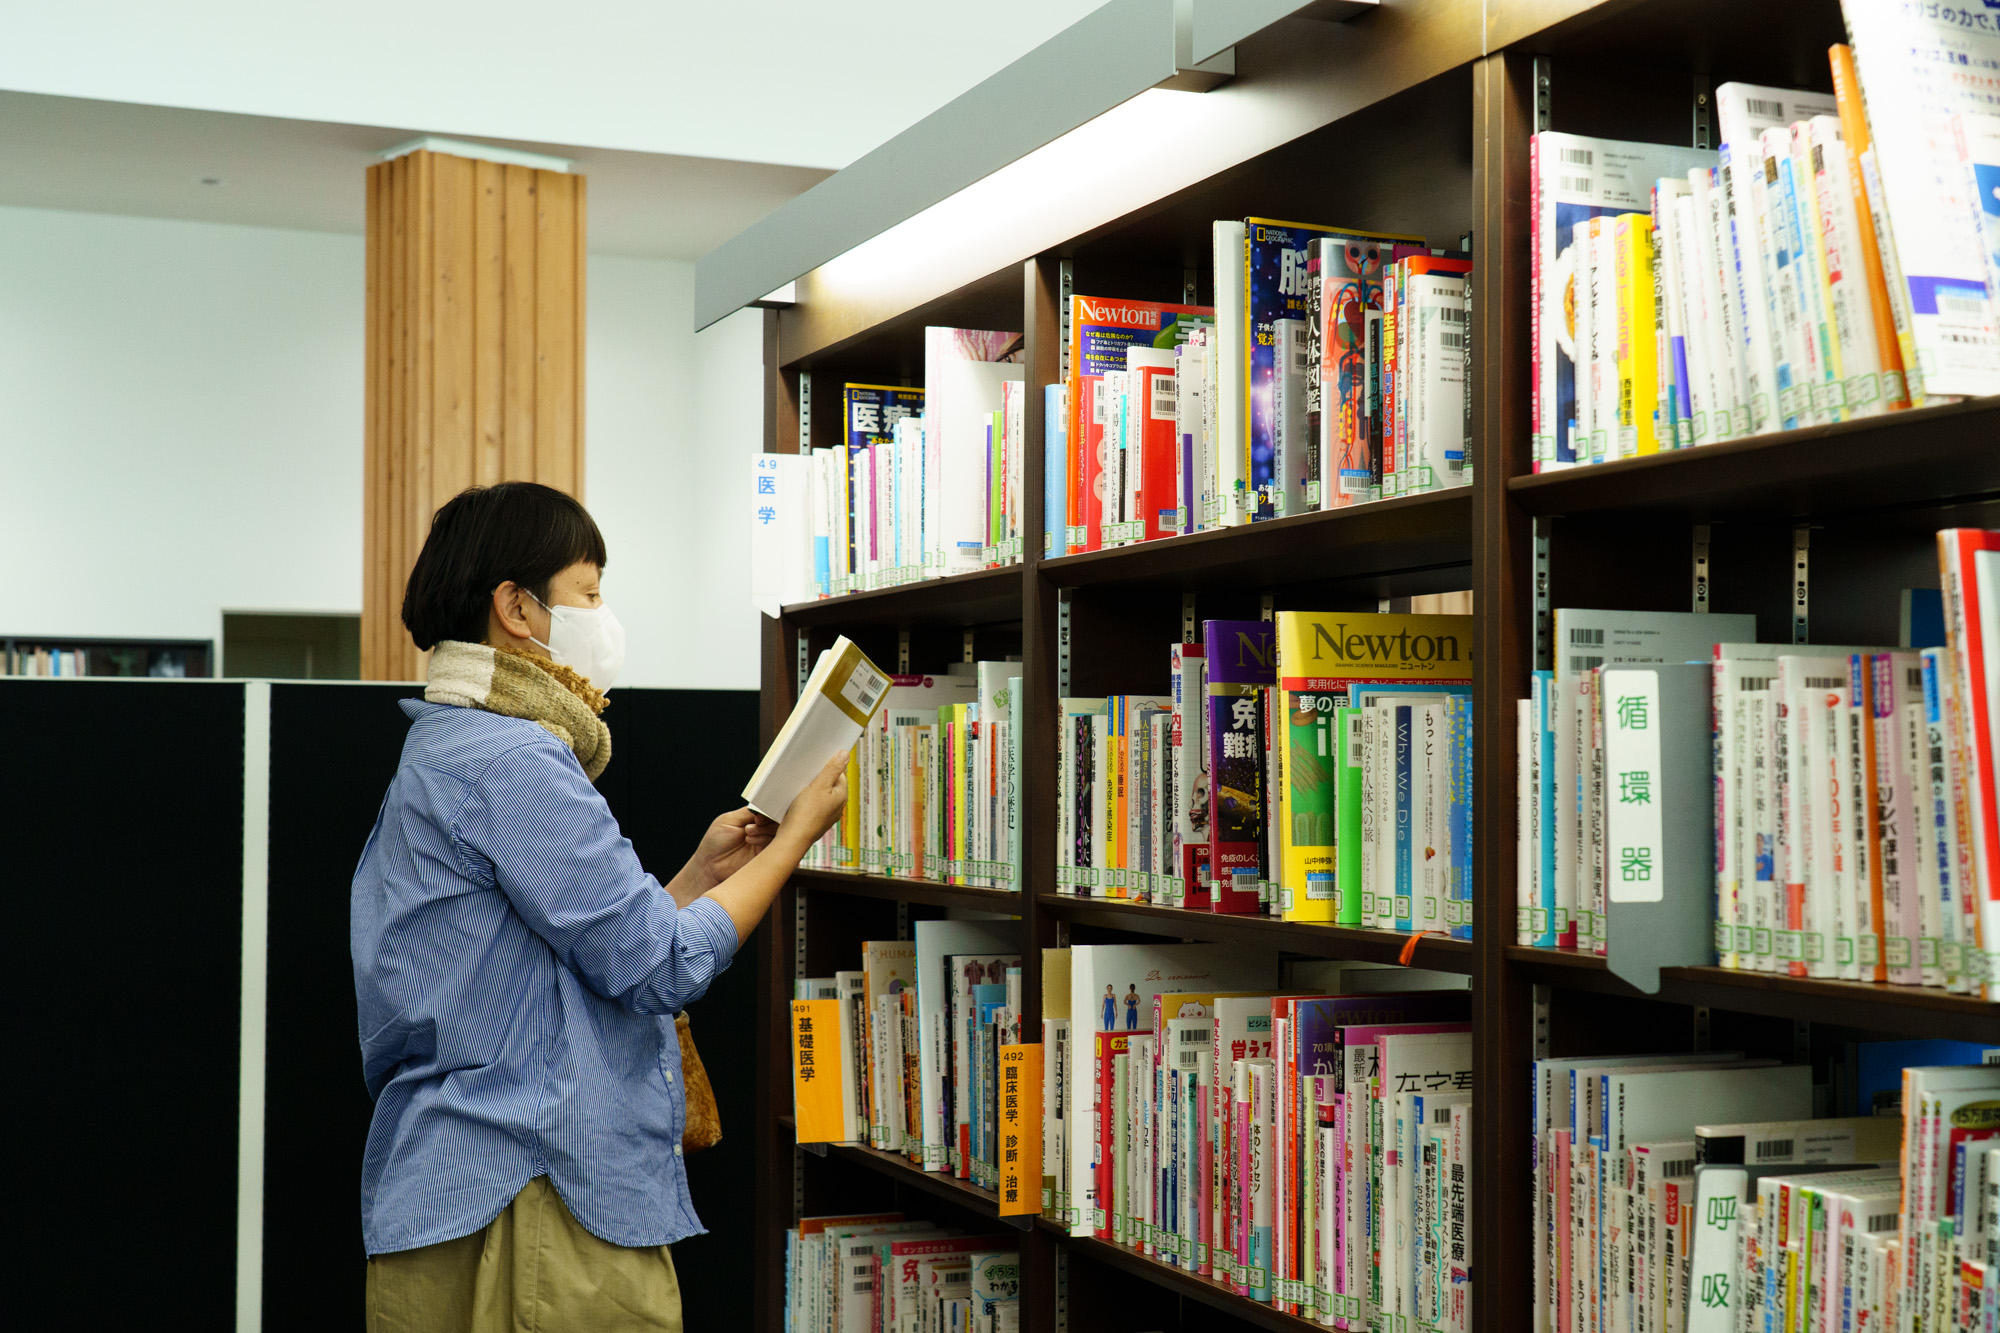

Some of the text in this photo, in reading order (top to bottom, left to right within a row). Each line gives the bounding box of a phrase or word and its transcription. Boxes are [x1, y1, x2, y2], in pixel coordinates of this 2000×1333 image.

[1265, 229, 1288, 238] NATIONAL
[1265, 235, 1294, 245] GEOGRAPHIC
[1078, 299, 1151, 325] Newton
[1307, 315, 1321, 413] 人体図鑑
[1383, 314, 1396, 437] 生理学の基本としくみ
[758, 459, 777, 470] 49
[758, 476, 777, 524] 医学
[1311, 623, 1461, 662] Newton
[1400, 662, 1436, 671] ニュートン
[1142, 719, 1150, 788] 人工培養された
[1363, 714, 1374, 842] 未知なる人体への旅
[1397, 723, 1408, 841] Why We Die
[1617, 695, 1653, 881] 循環器
[1304, 857, 1333, 865] 山中伸弥
[880, 949, 914, 959] HUMA
[793, 1005, 811, 1013] 491
[798, 1016, 816, 1082] 基礎医学
[1003, 1052, 1024, 1062] 492
[1005, 1065, 1019, 1204] 臨床医学、診断・治療
[1253, 1124, 1261, 1193] 体のトリセツ
[1451, 1163, 1465, 1262] 最先端医療
[901, 1244, 955, 1255] マンガでわかる
[1701, 1195, 1737, 1309] 呼吸
[985, 1264, 1019, 1281] イラス
